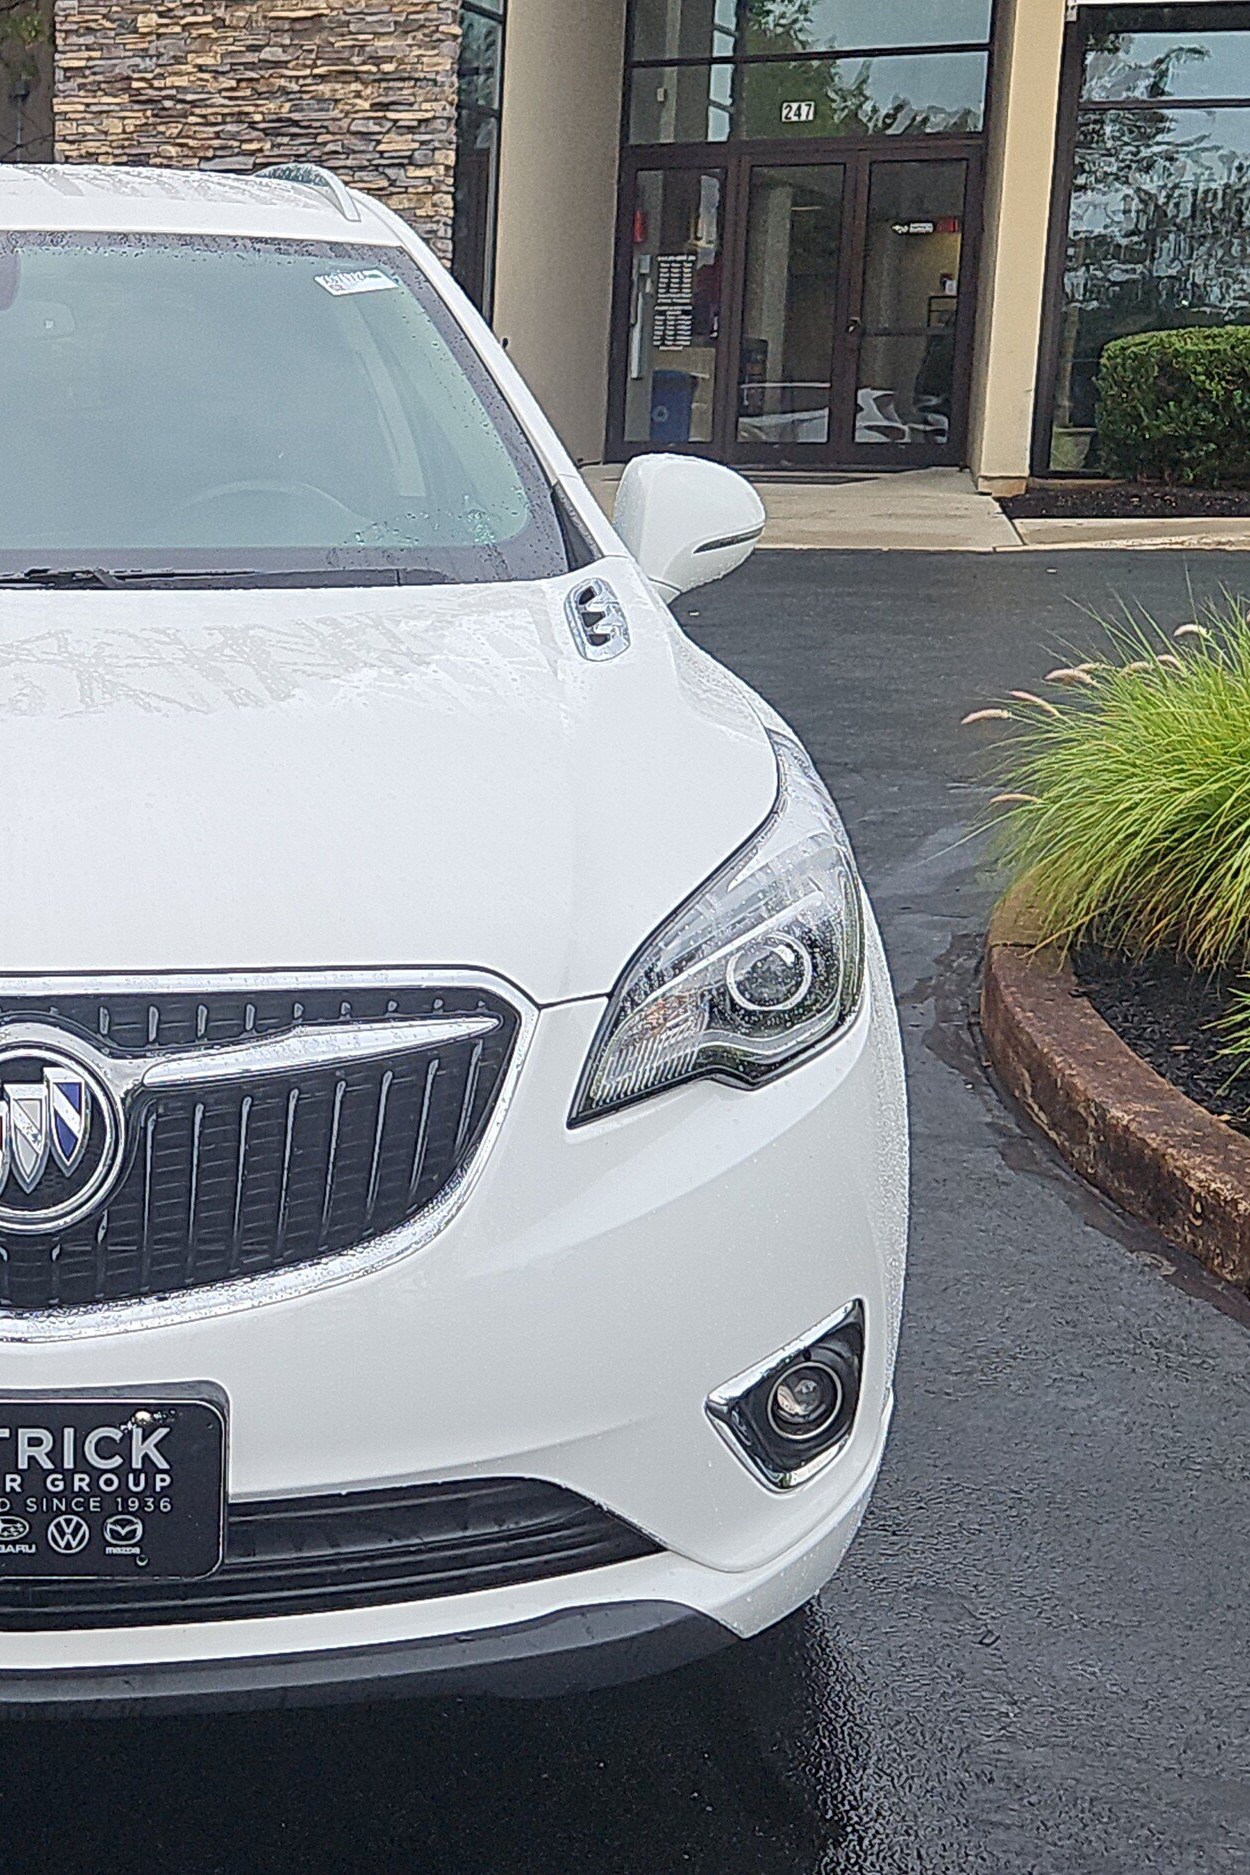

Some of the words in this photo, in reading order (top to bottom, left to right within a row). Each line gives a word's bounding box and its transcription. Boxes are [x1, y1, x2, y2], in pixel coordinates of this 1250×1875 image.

[784, 103, 812, 120] 247
[46, 1473, 171, 1492] GROUP
[25, 1497, 102, 1512] SINCE
[115, 1497, 171, 1513] 1936
